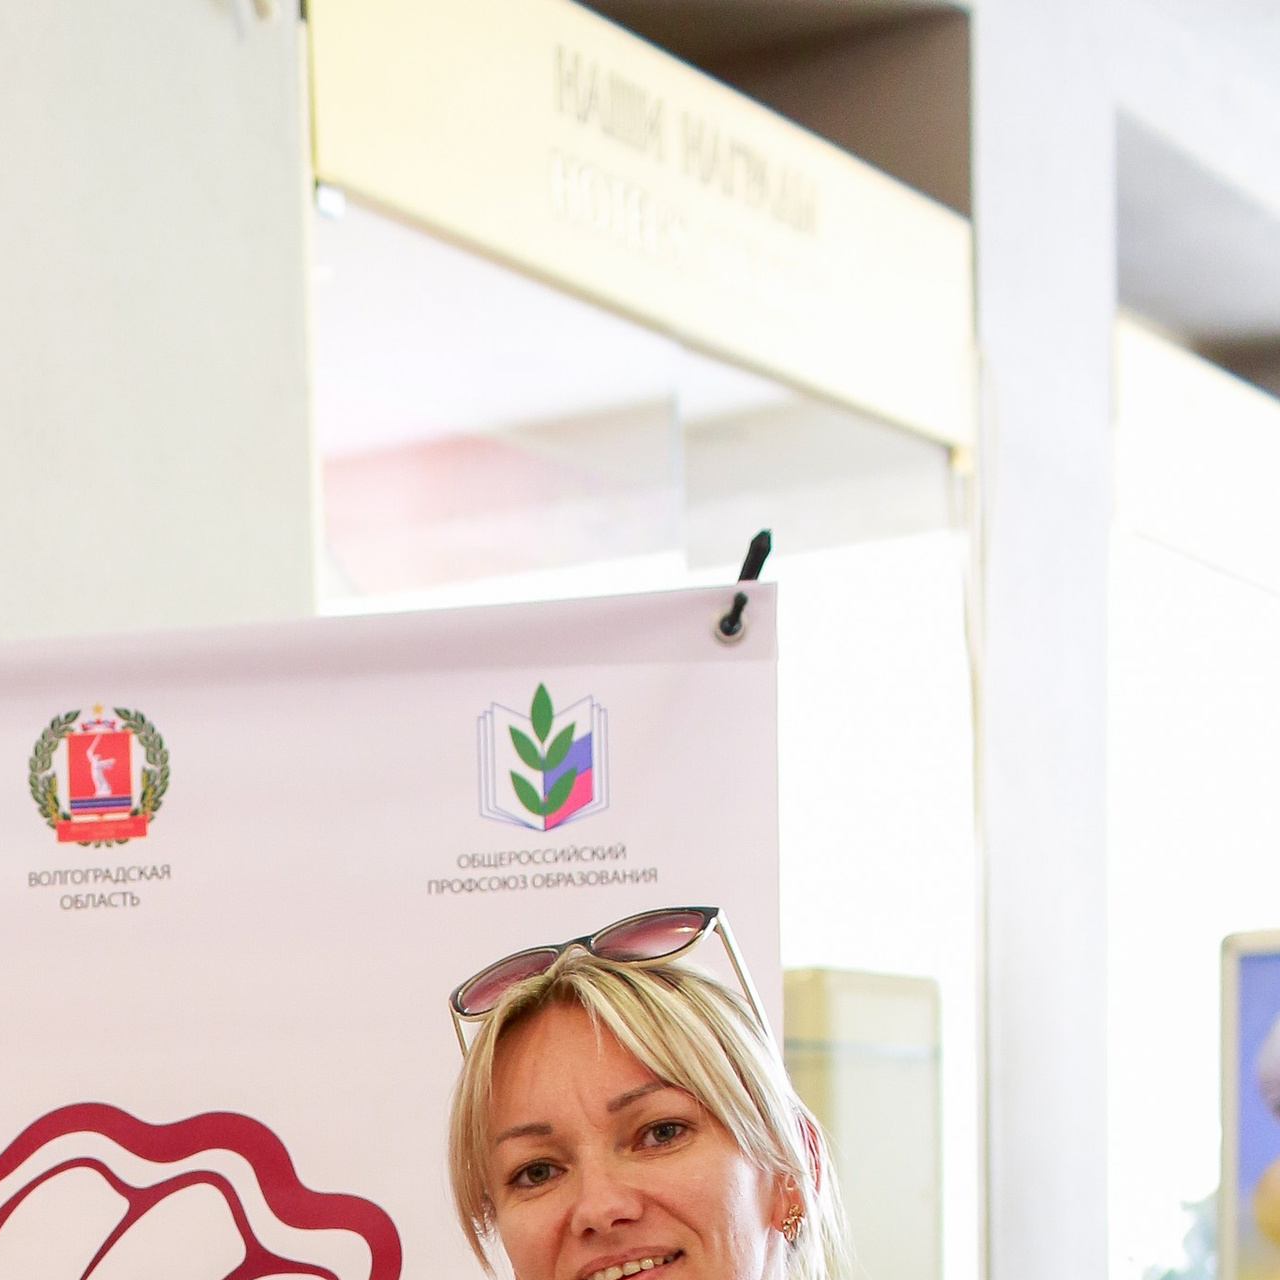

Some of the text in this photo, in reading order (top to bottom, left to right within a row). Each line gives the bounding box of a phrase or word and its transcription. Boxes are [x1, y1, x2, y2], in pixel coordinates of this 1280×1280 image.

[457, 844, 626, 869] ОБЩЕРОССИЙСКИЙ
[28, 864, 170, 887] ВОЛГОГРАДСКАЯ
[428, 868, 658, 895] ПРОФСОЮЗ ОБРАЗОВАНИЯ
[60, 891, 140, 910] ОБЛАСТЬ
